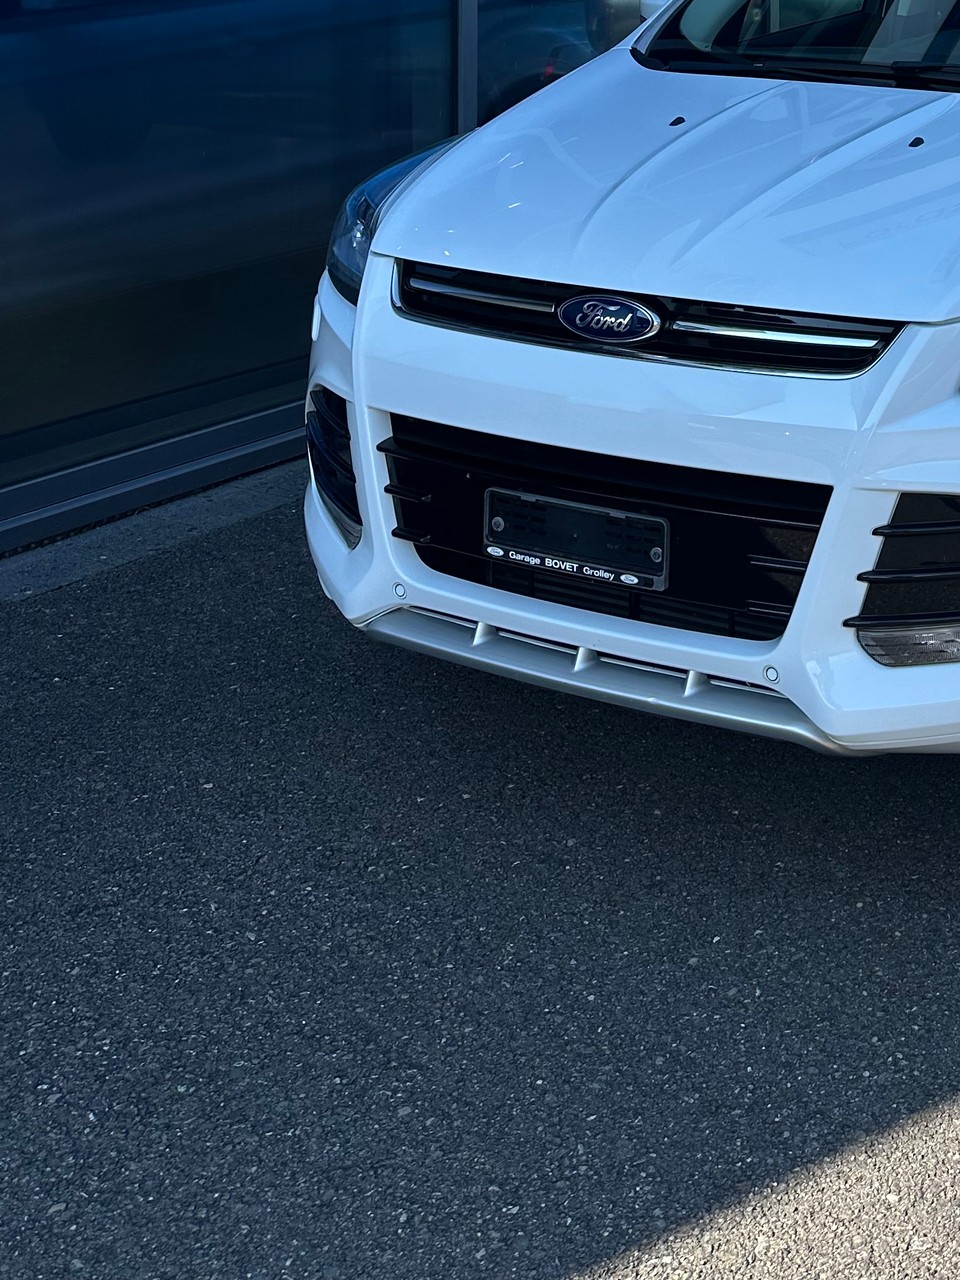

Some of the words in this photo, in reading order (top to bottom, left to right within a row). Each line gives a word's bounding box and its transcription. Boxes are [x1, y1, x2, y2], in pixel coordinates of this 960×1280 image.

[575, 301, 633, 333] Ford
[508, 550, 541, 565] Garage
[545, 558, 578, 572] BOVET
[583, 566, 615, 581] Grolley
